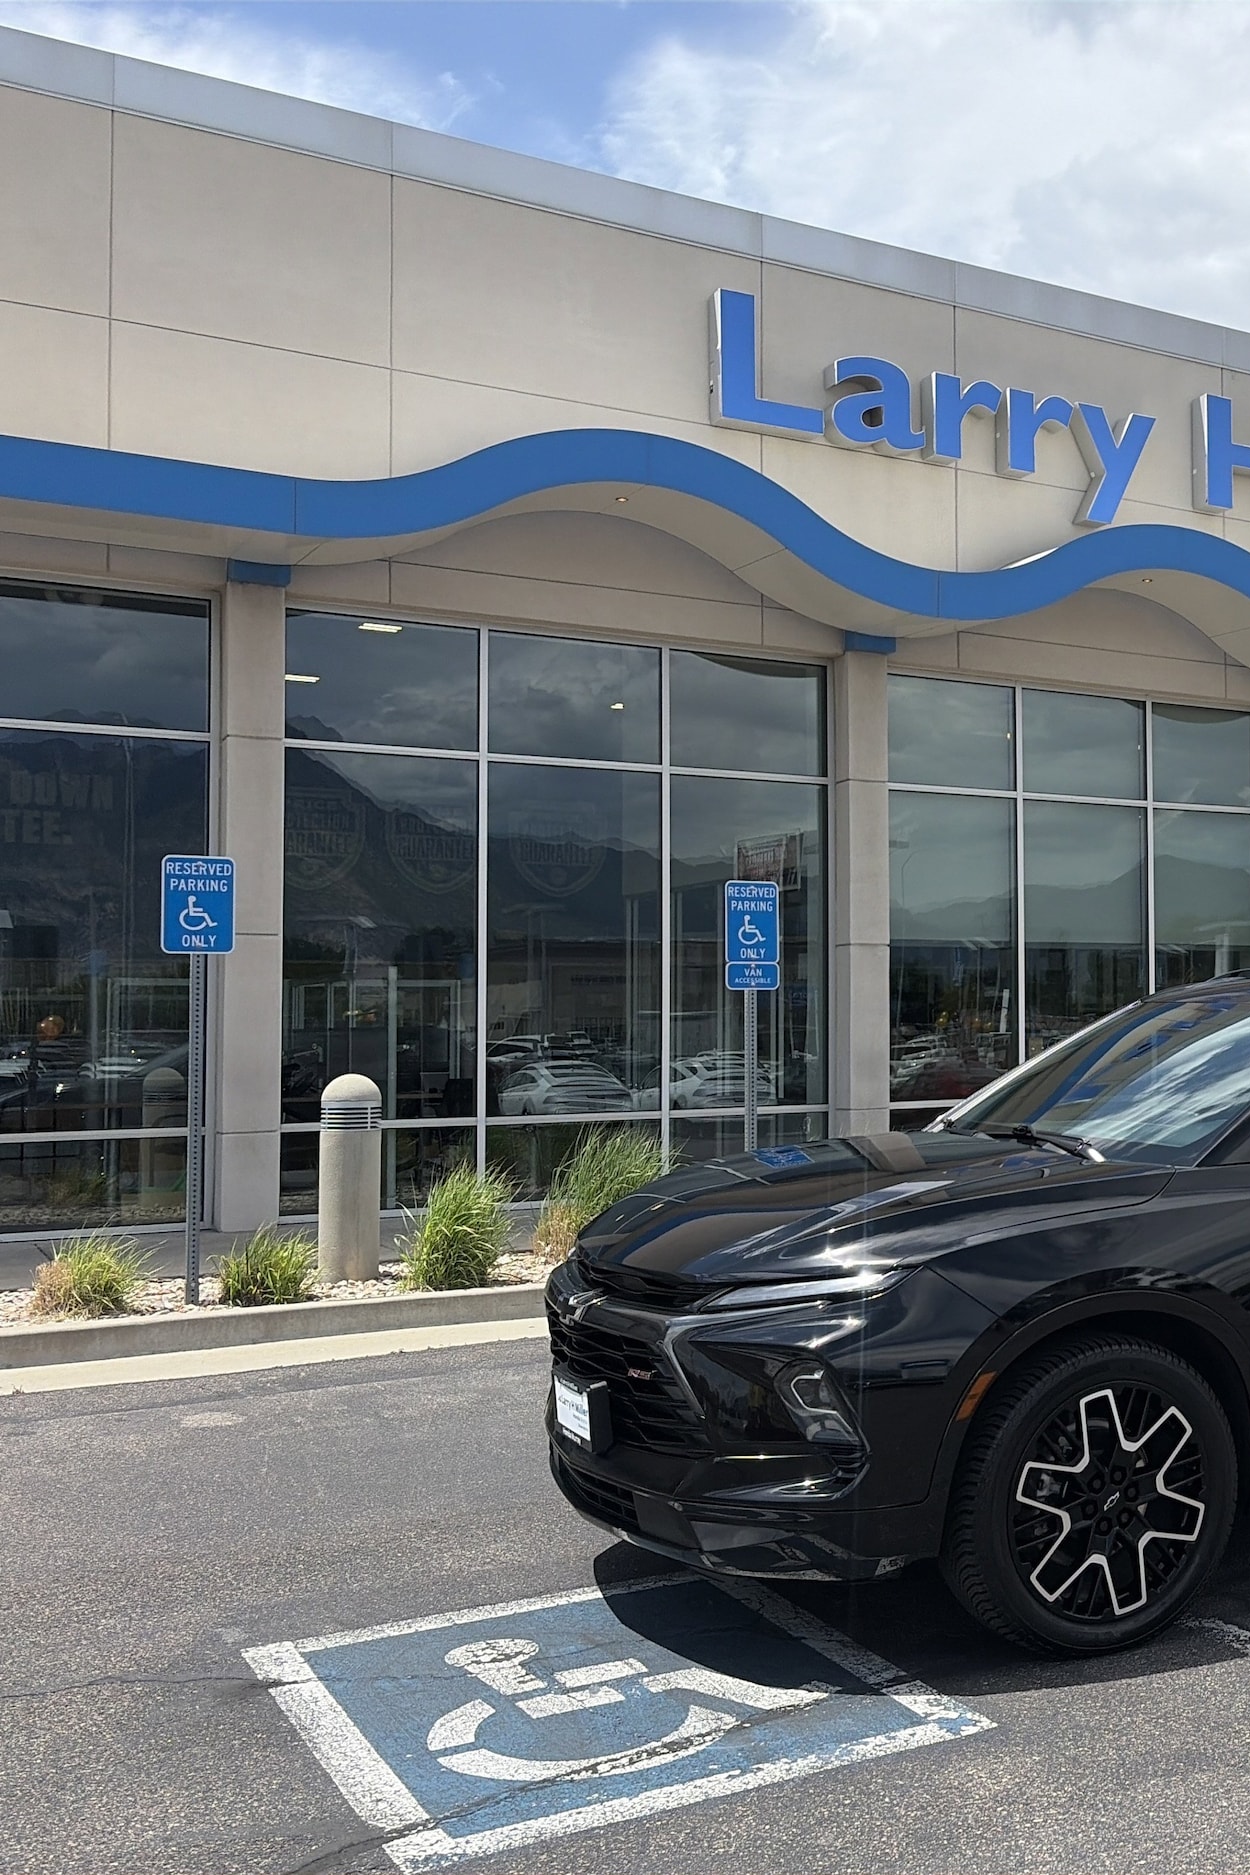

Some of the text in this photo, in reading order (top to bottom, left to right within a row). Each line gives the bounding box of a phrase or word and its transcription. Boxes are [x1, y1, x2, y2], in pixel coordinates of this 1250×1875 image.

[714, 287, 1157, 526] Larry
[166, 861, 232, 876] RESERVED
[170, 879, 228, 892] PARKING
[728, 886, 775, 898] RESERVED
[731, 901, 773, 912] PARKING
[182, 935, 217, 947] ONLY
[740, 948, 766, 959] ONLY
[744, 968, 762, 977] VAN
